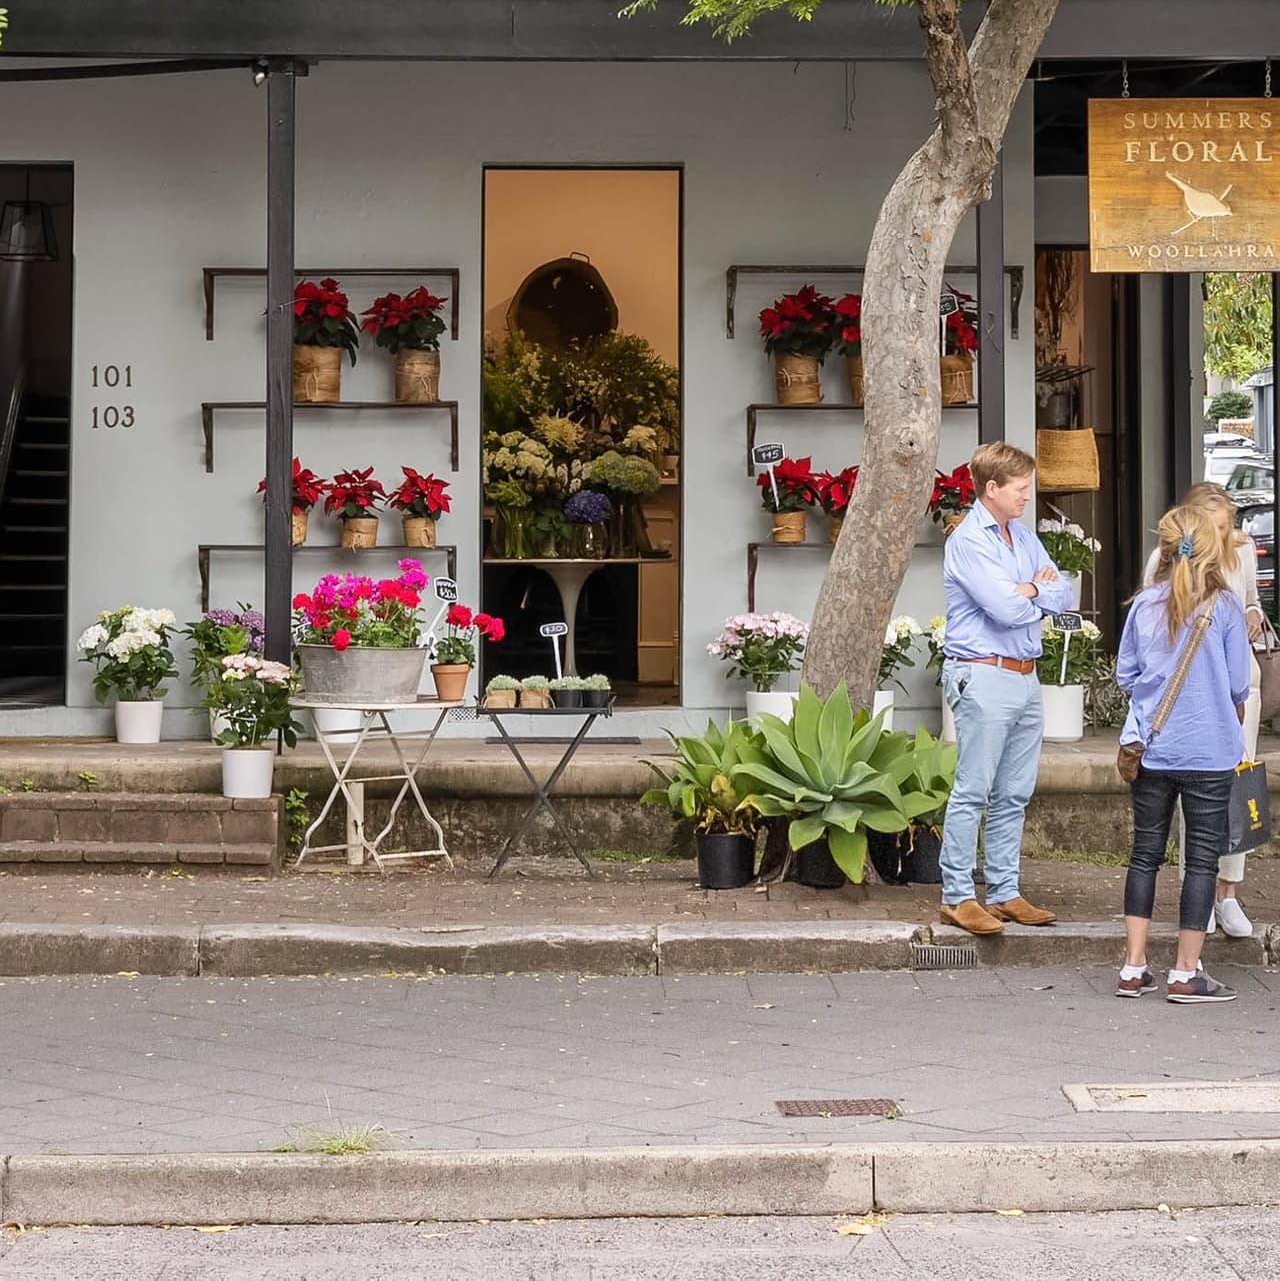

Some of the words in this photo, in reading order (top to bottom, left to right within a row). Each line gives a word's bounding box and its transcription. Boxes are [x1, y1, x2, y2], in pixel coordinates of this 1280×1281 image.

[1123, 111, 1273, 130] SUMMERS
[1125, 140, 1273, 163] FLORAL
[1127, 244, 1276, 259] WOOLLAHRA
[92, 365, 132, 388] 101
[92, 406, 135, 429] 103
